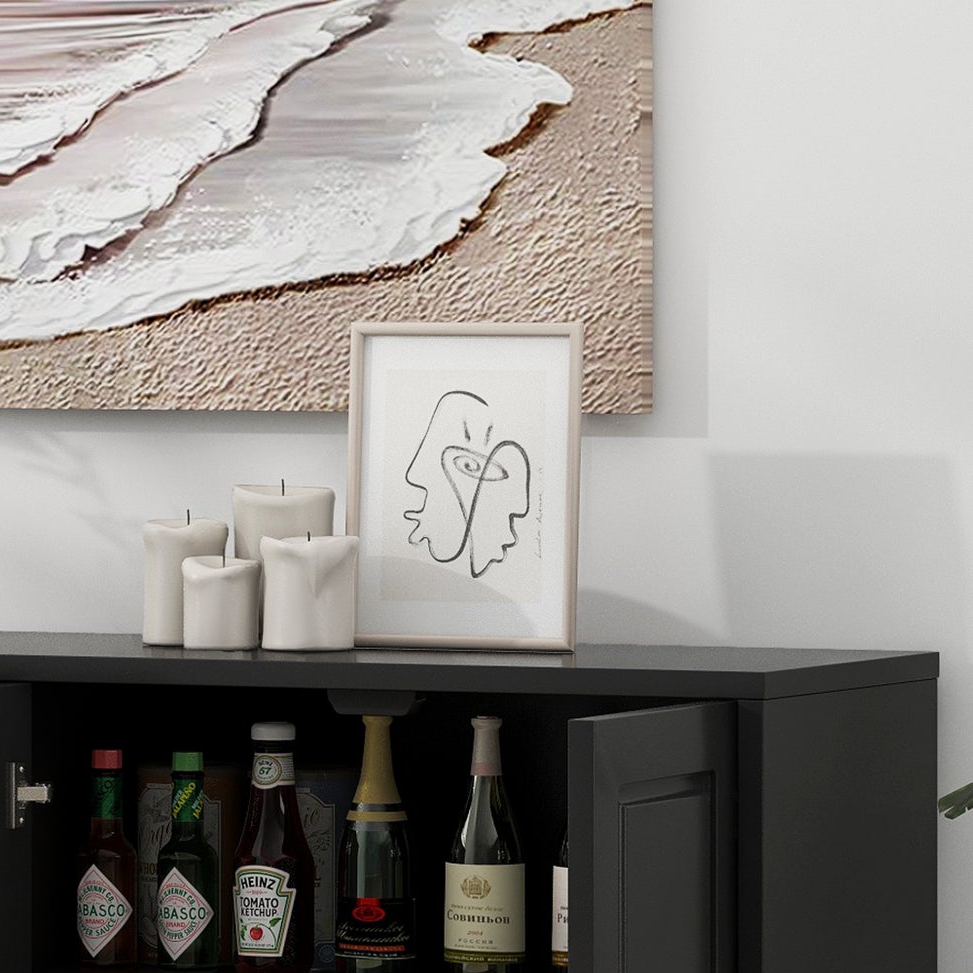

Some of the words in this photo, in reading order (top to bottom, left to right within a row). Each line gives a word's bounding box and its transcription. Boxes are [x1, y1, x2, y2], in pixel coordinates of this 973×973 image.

[240, 876, 276, 890] HEINZ
[240, 896, 279, 908] TOMATO
[77, 904, 125, 917] ABASCO
[158, 907, 206, 920] ABASCO
[240, 907, 278, 917] KETCHUP
[447, 909, 510, 924] Совиньон
